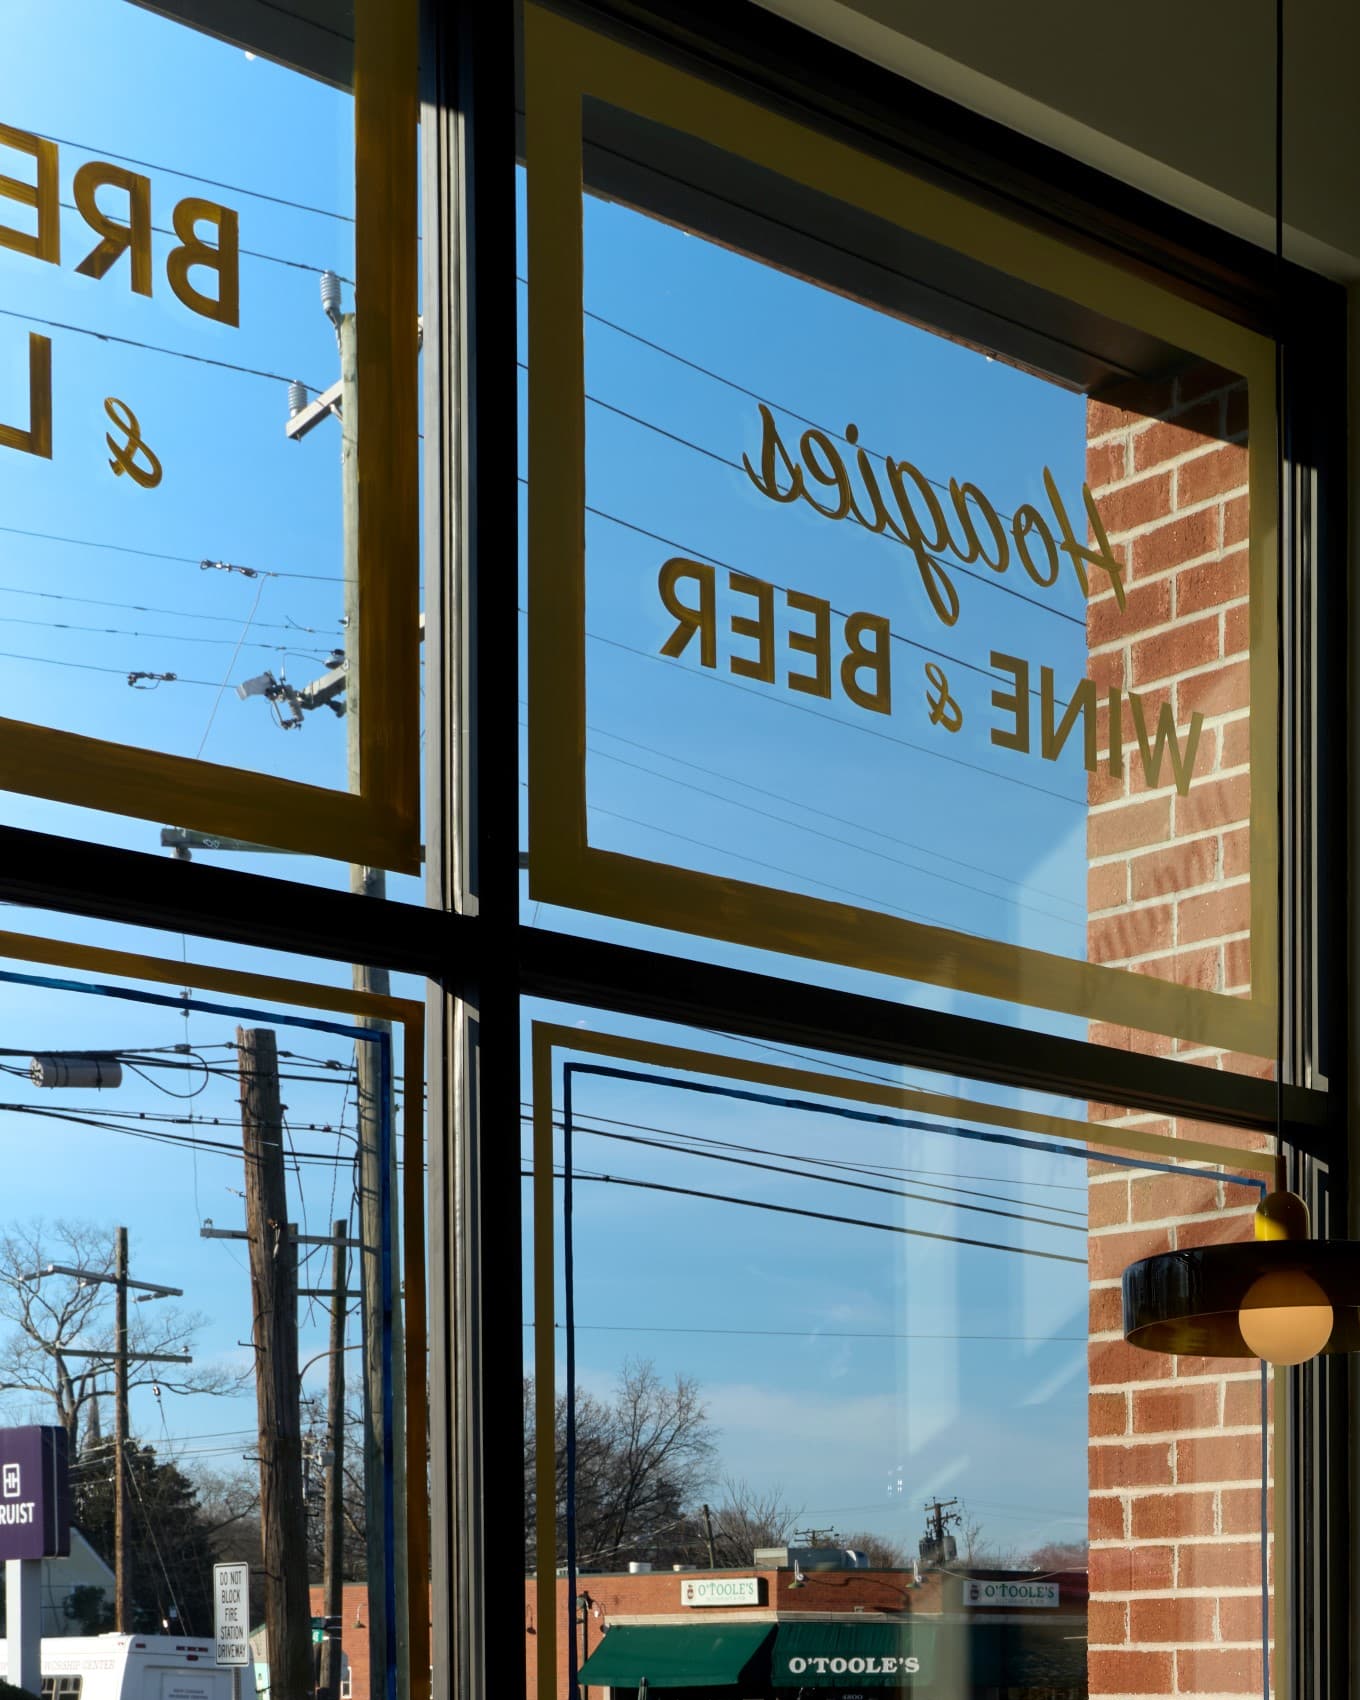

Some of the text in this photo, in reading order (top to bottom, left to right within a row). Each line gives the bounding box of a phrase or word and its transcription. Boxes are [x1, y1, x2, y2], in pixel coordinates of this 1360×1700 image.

[220, 1571, 242, 1585] DO NOT
[698, 1582, 754, 1596] O'TOOLE'S
[985, 1584, 1055, 1598] O'TOOLE'S
[221, 1589, 240, 1604] BLOCK
[225, 1608, 238, 1621] FIRE
[221, 1625, 243, 1640] STATION
[218, 1644, 247, 1658] DRIVEWAY
[789, 1657, 920, 1674] O'TOOLE'S
